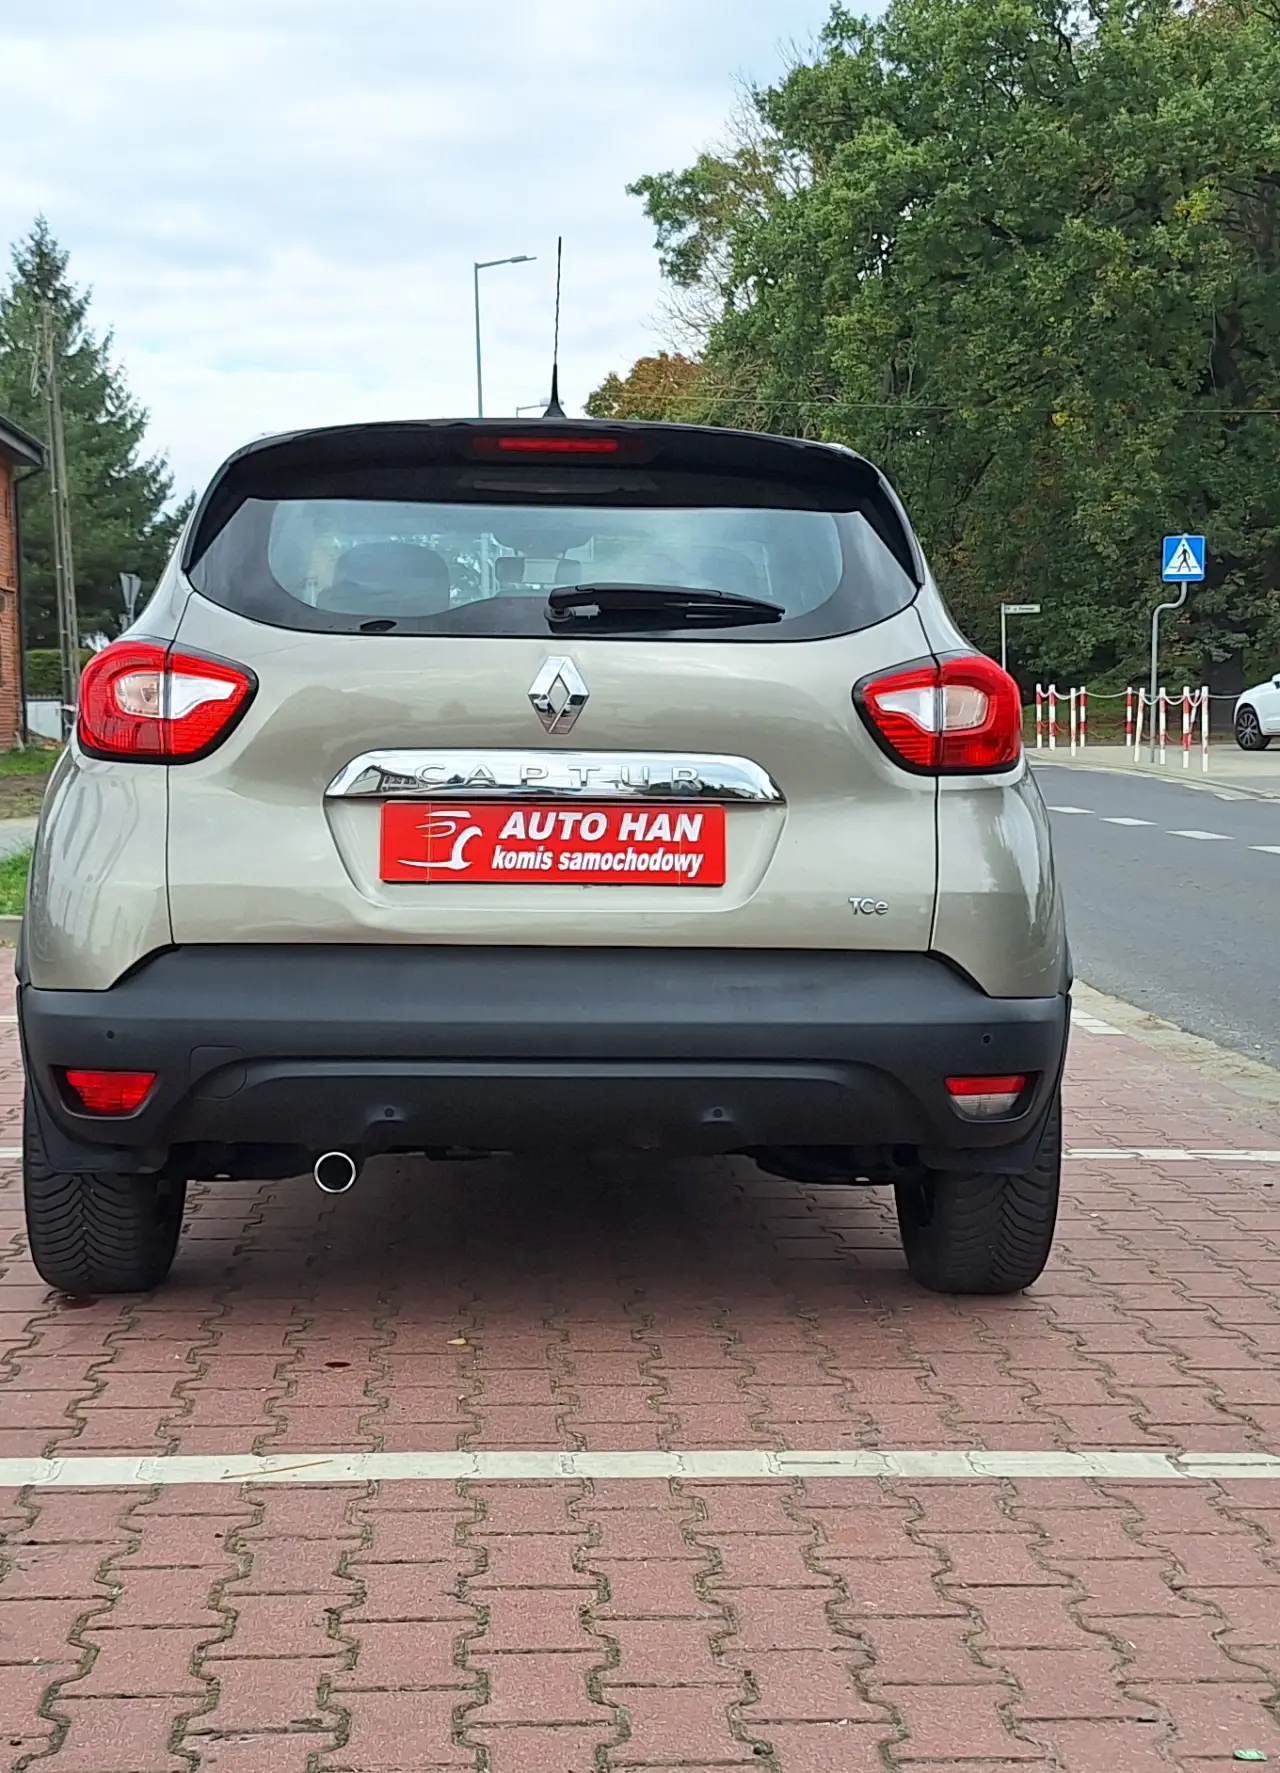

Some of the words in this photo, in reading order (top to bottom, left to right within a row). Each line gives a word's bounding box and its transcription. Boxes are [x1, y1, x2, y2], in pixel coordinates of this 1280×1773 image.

[414, 763, 704, 791] CAPTUR
[498, 811, 608, 841] AUTO
[618, 812, 705, 843] HAN
[491, 844, 553, 871] komis
[557, 846, 705, 878] samochodowy
[848, 897, 888, 915] TCe
